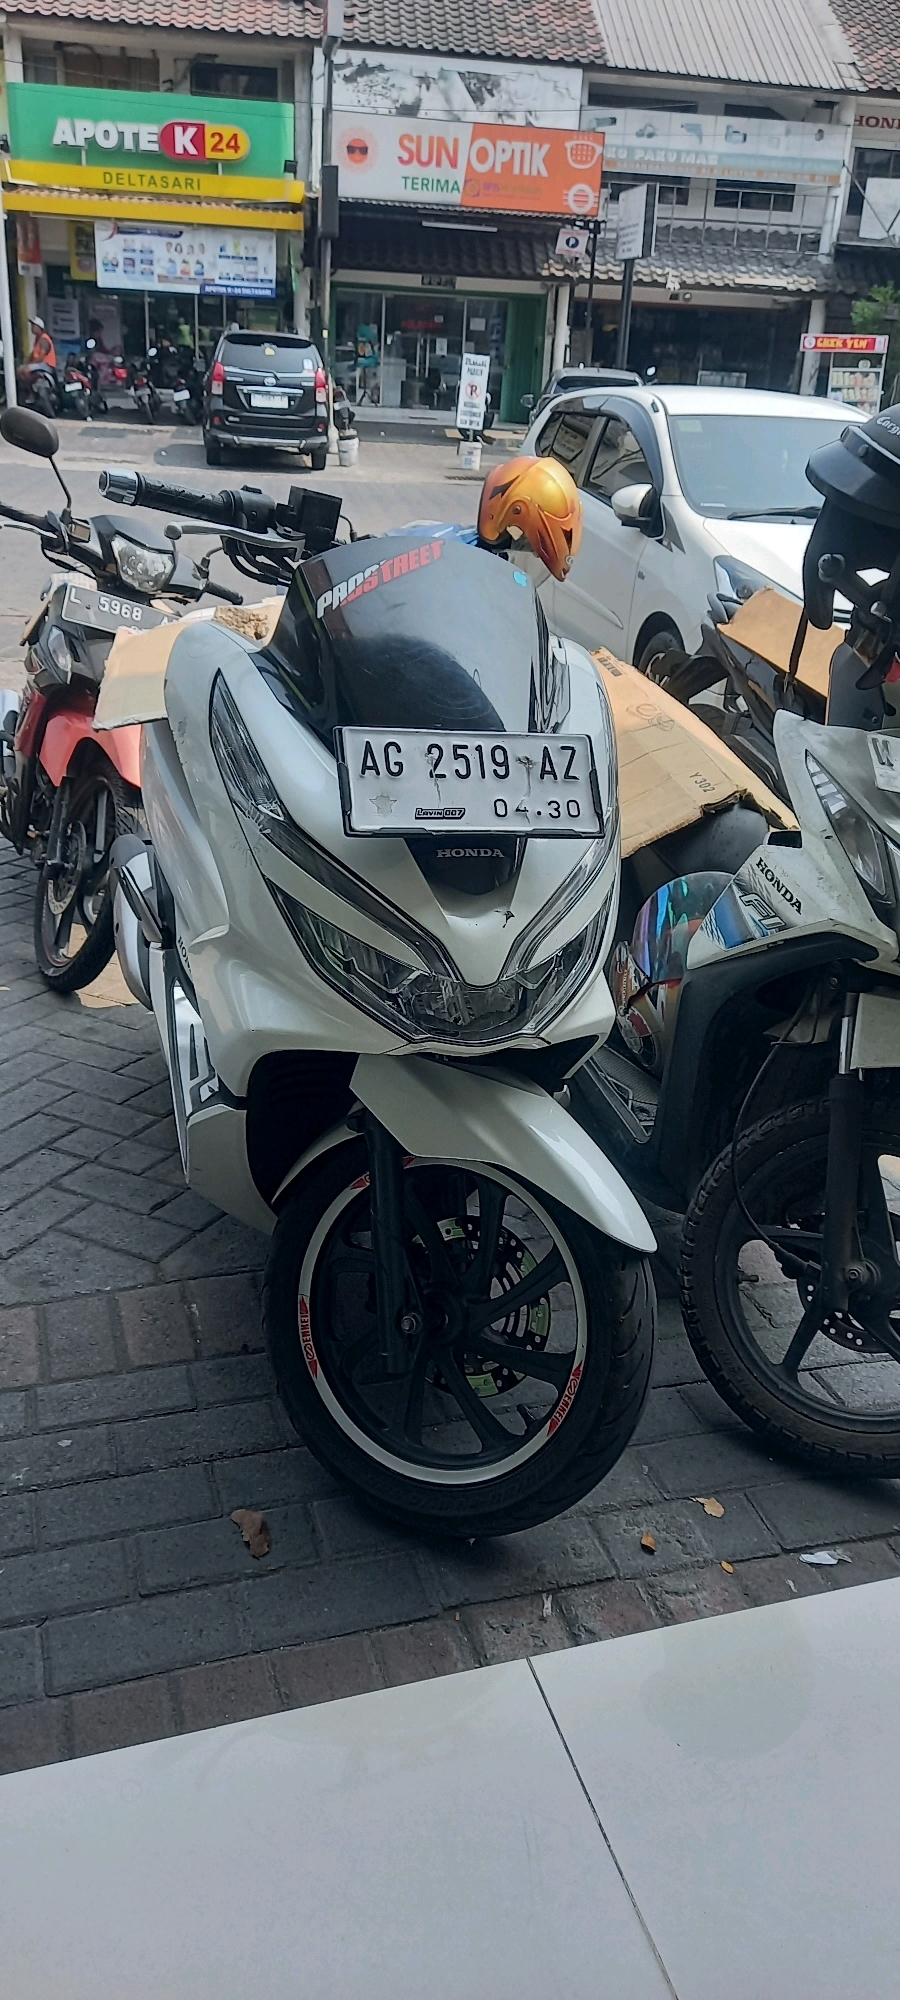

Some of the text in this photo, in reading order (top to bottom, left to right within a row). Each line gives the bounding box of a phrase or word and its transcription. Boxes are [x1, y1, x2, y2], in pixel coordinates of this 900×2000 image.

[854, 115, 900, 130] HON
[210, 132, 241, 154] 24
[397, 133, 551, 178] SUN OPTIK
[103, 170, 201, 191] DELTASARI
[402, 175, 461, 194] TERIMA
[876, 416, 900, 436] Carg
[316, 540, 444, 619] PROSTREET
[69, 587, 82, 605] L
[98, 595, 143, 621] 5968
[360, 740, 580, 781] AG 2519 AZ
[689, 771, 716, 793] Y302
[444, 809, 463, 817] 007
[436, 848, 505, 858] HONDA
[755, 856, 802, 915] HONDA
